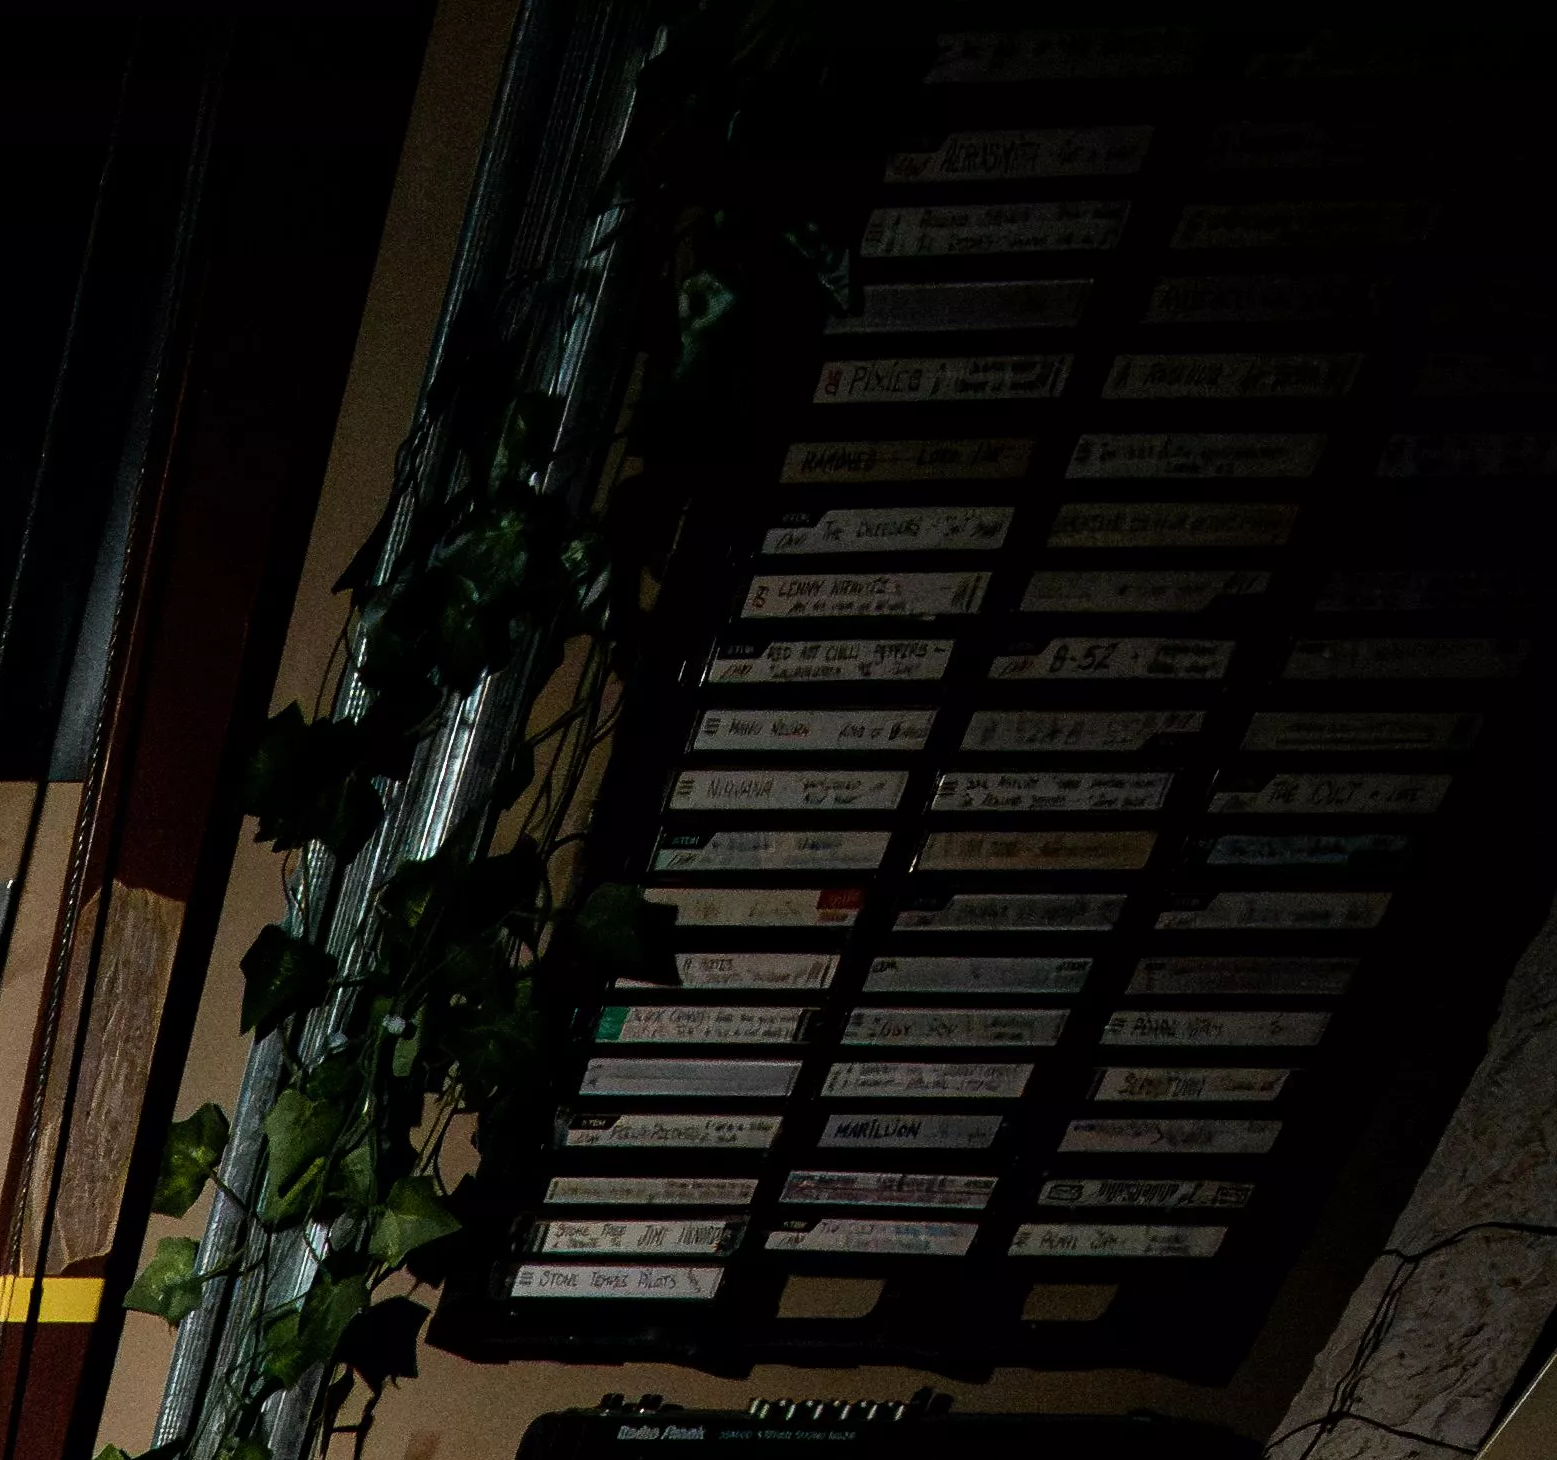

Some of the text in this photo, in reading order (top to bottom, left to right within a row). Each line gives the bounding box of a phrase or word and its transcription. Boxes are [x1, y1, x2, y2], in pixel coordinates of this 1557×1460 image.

[849, 361, 923, 395] PIXIES
[778, 581, 823, 597] LENNY
[707, 779, 774, 798] NIRVANA
[834, 1119, 921, 1139] MARILLION
[539, 1270, 578, 1288] STONE
[638, 1269, 676, 1288] PILOTS
